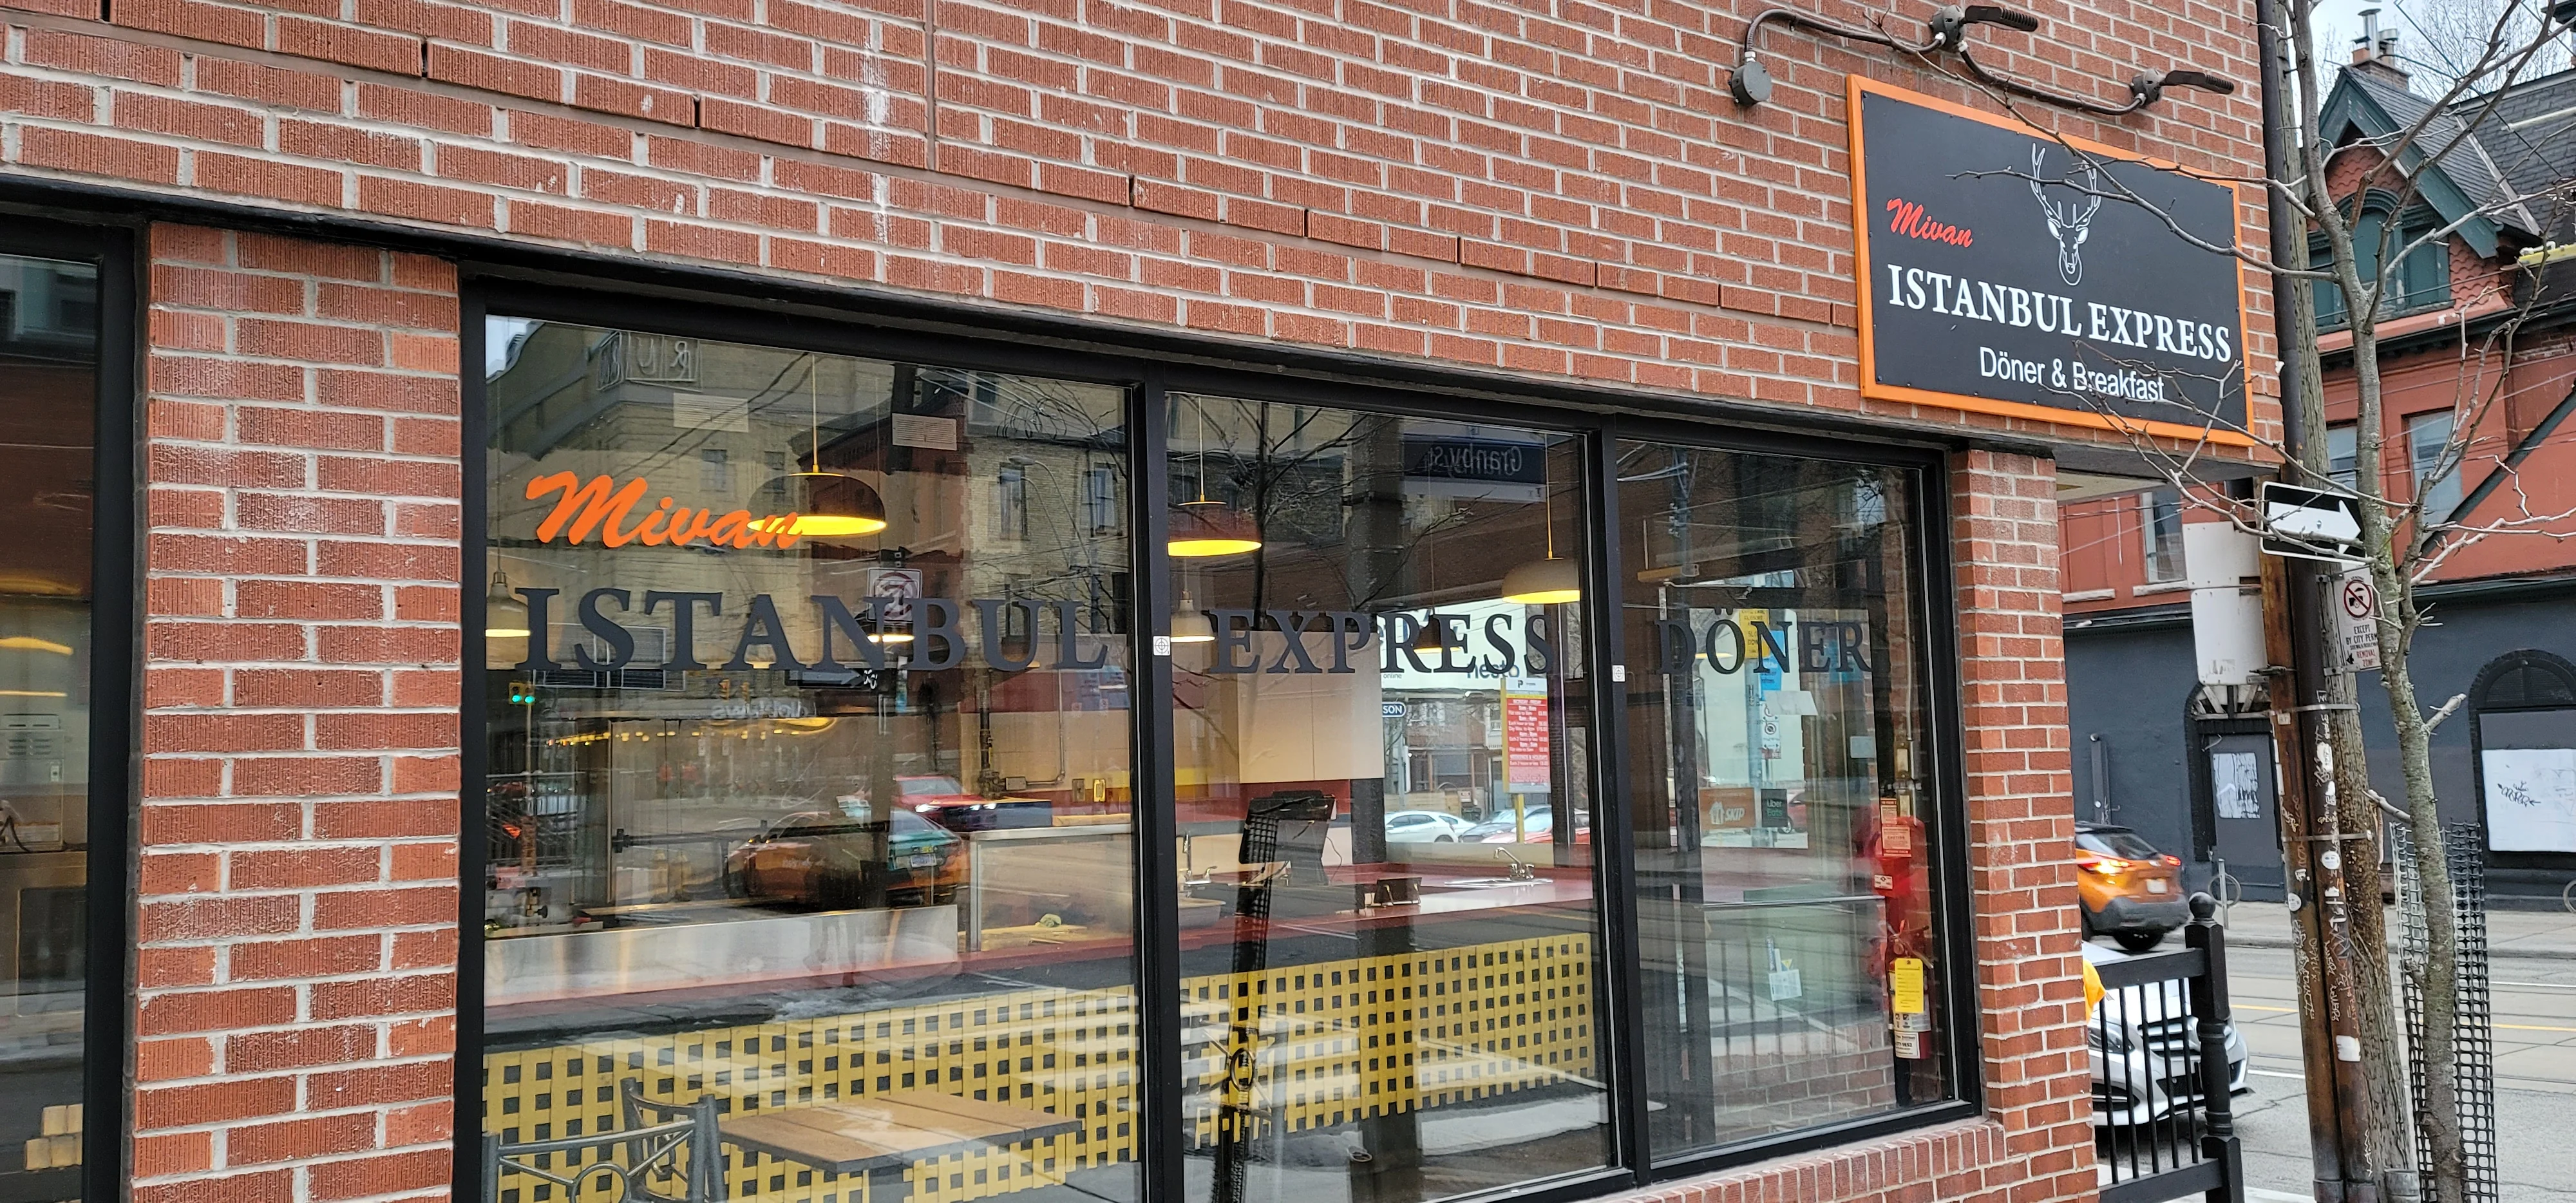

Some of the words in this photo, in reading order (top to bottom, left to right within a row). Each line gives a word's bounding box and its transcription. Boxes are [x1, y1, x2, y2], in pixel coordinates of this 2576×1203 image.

[1887, 198, 1973, 248] Mivan
[1887, 263, 2081, 337] ISTANBUL
[2088, 302, 2232, 363] EXPRESS
[1980, 346, 2045, 385] Döner
[2052, 358, 2067, 387] &
[2073, 365, 2164, 401] Breakfast
[526, 470, 805, 549] Mivan
[515, 587, 1108, 672] ISTANBUL
[1208, 610, 1553, 674] EXPRESS
[1654, 606, 1873, 675] DÖNER
[2345, 637, 2352, 645] BY
[2353, 635, 2363, 644] CITY
[2365, 633, 2378, 642] PERM
[2354, 624, 2371, 634] EXCEPT
[1725, 808, 1745, 822] SKIP
[1766, 799, 1783, 808] Uber
